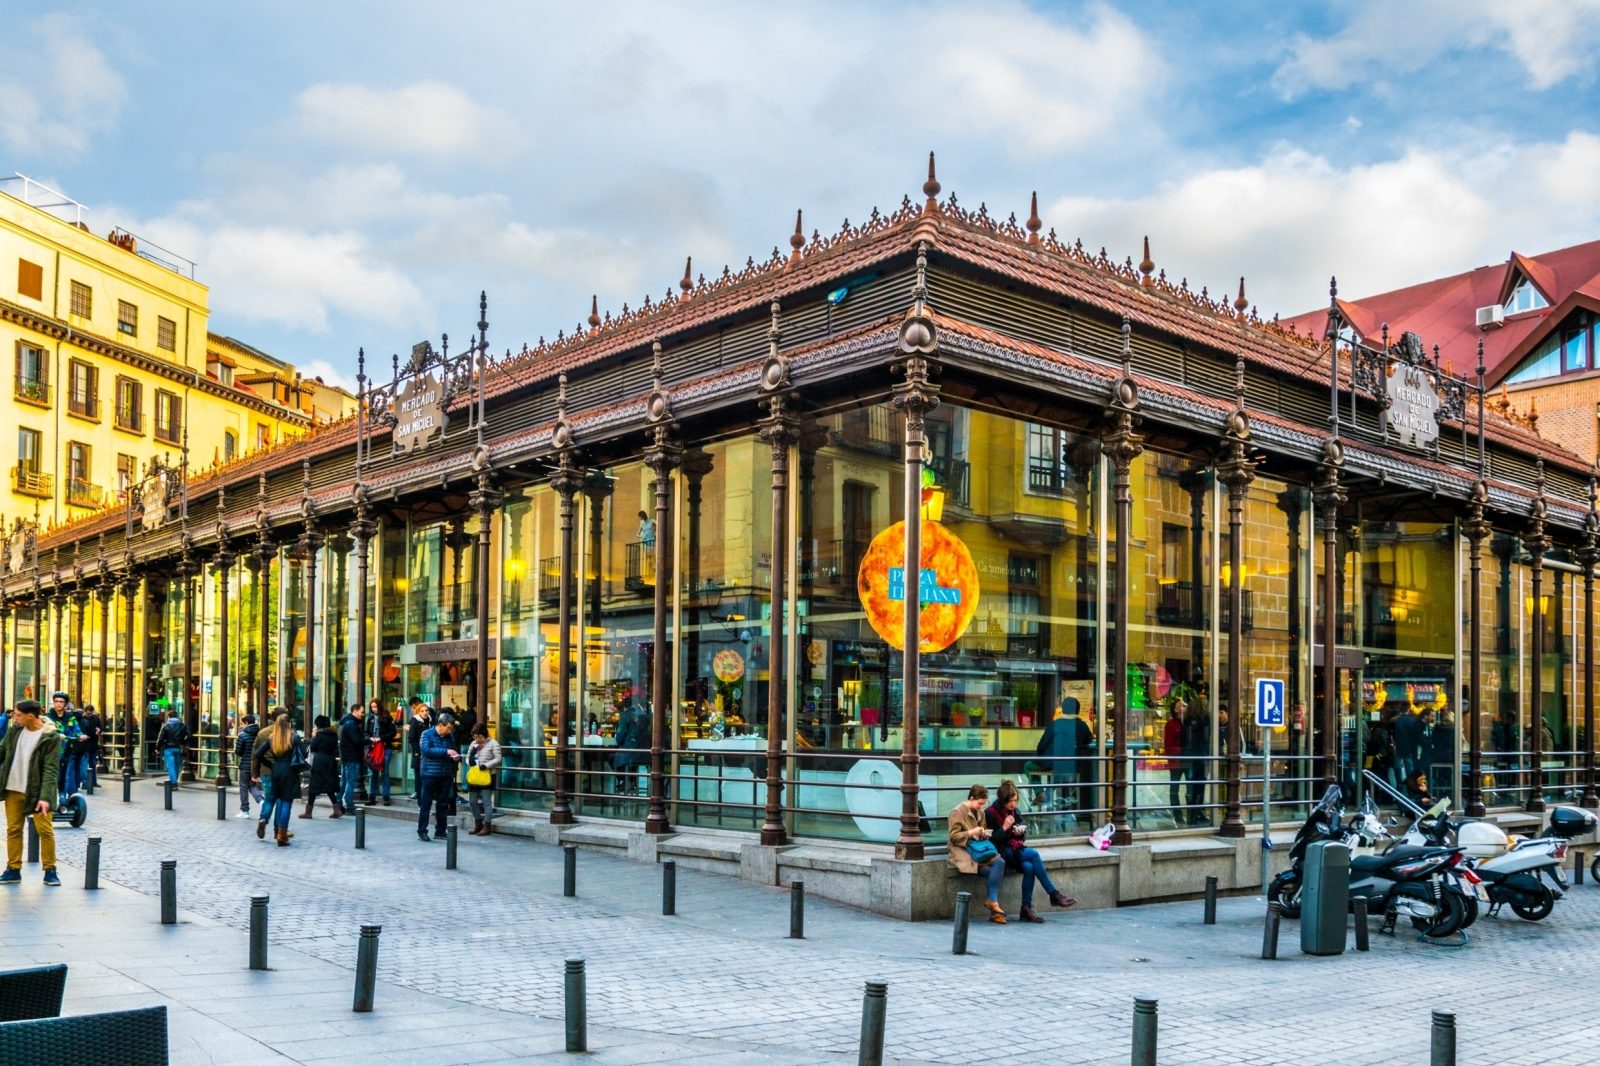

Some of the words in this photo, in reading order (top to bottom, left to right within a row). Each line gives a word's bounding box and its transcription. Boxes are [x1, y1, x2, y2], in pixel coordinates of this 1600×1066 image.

[401, 391, 435, 413] MERCADO
[1396, 386, 1432, 408] MERCADO
[413, 409, 422, 419] DE
[1409, 404, 1420, 415] DE
[398, 423, 411, 438] SAN
[412, 416, 435, 433] MIGUEL
[1393, 411, 1408, 427] SAN
[1410, 414, 1433, 434] MIGUEL
[1264, 684, 1276, 720] P
